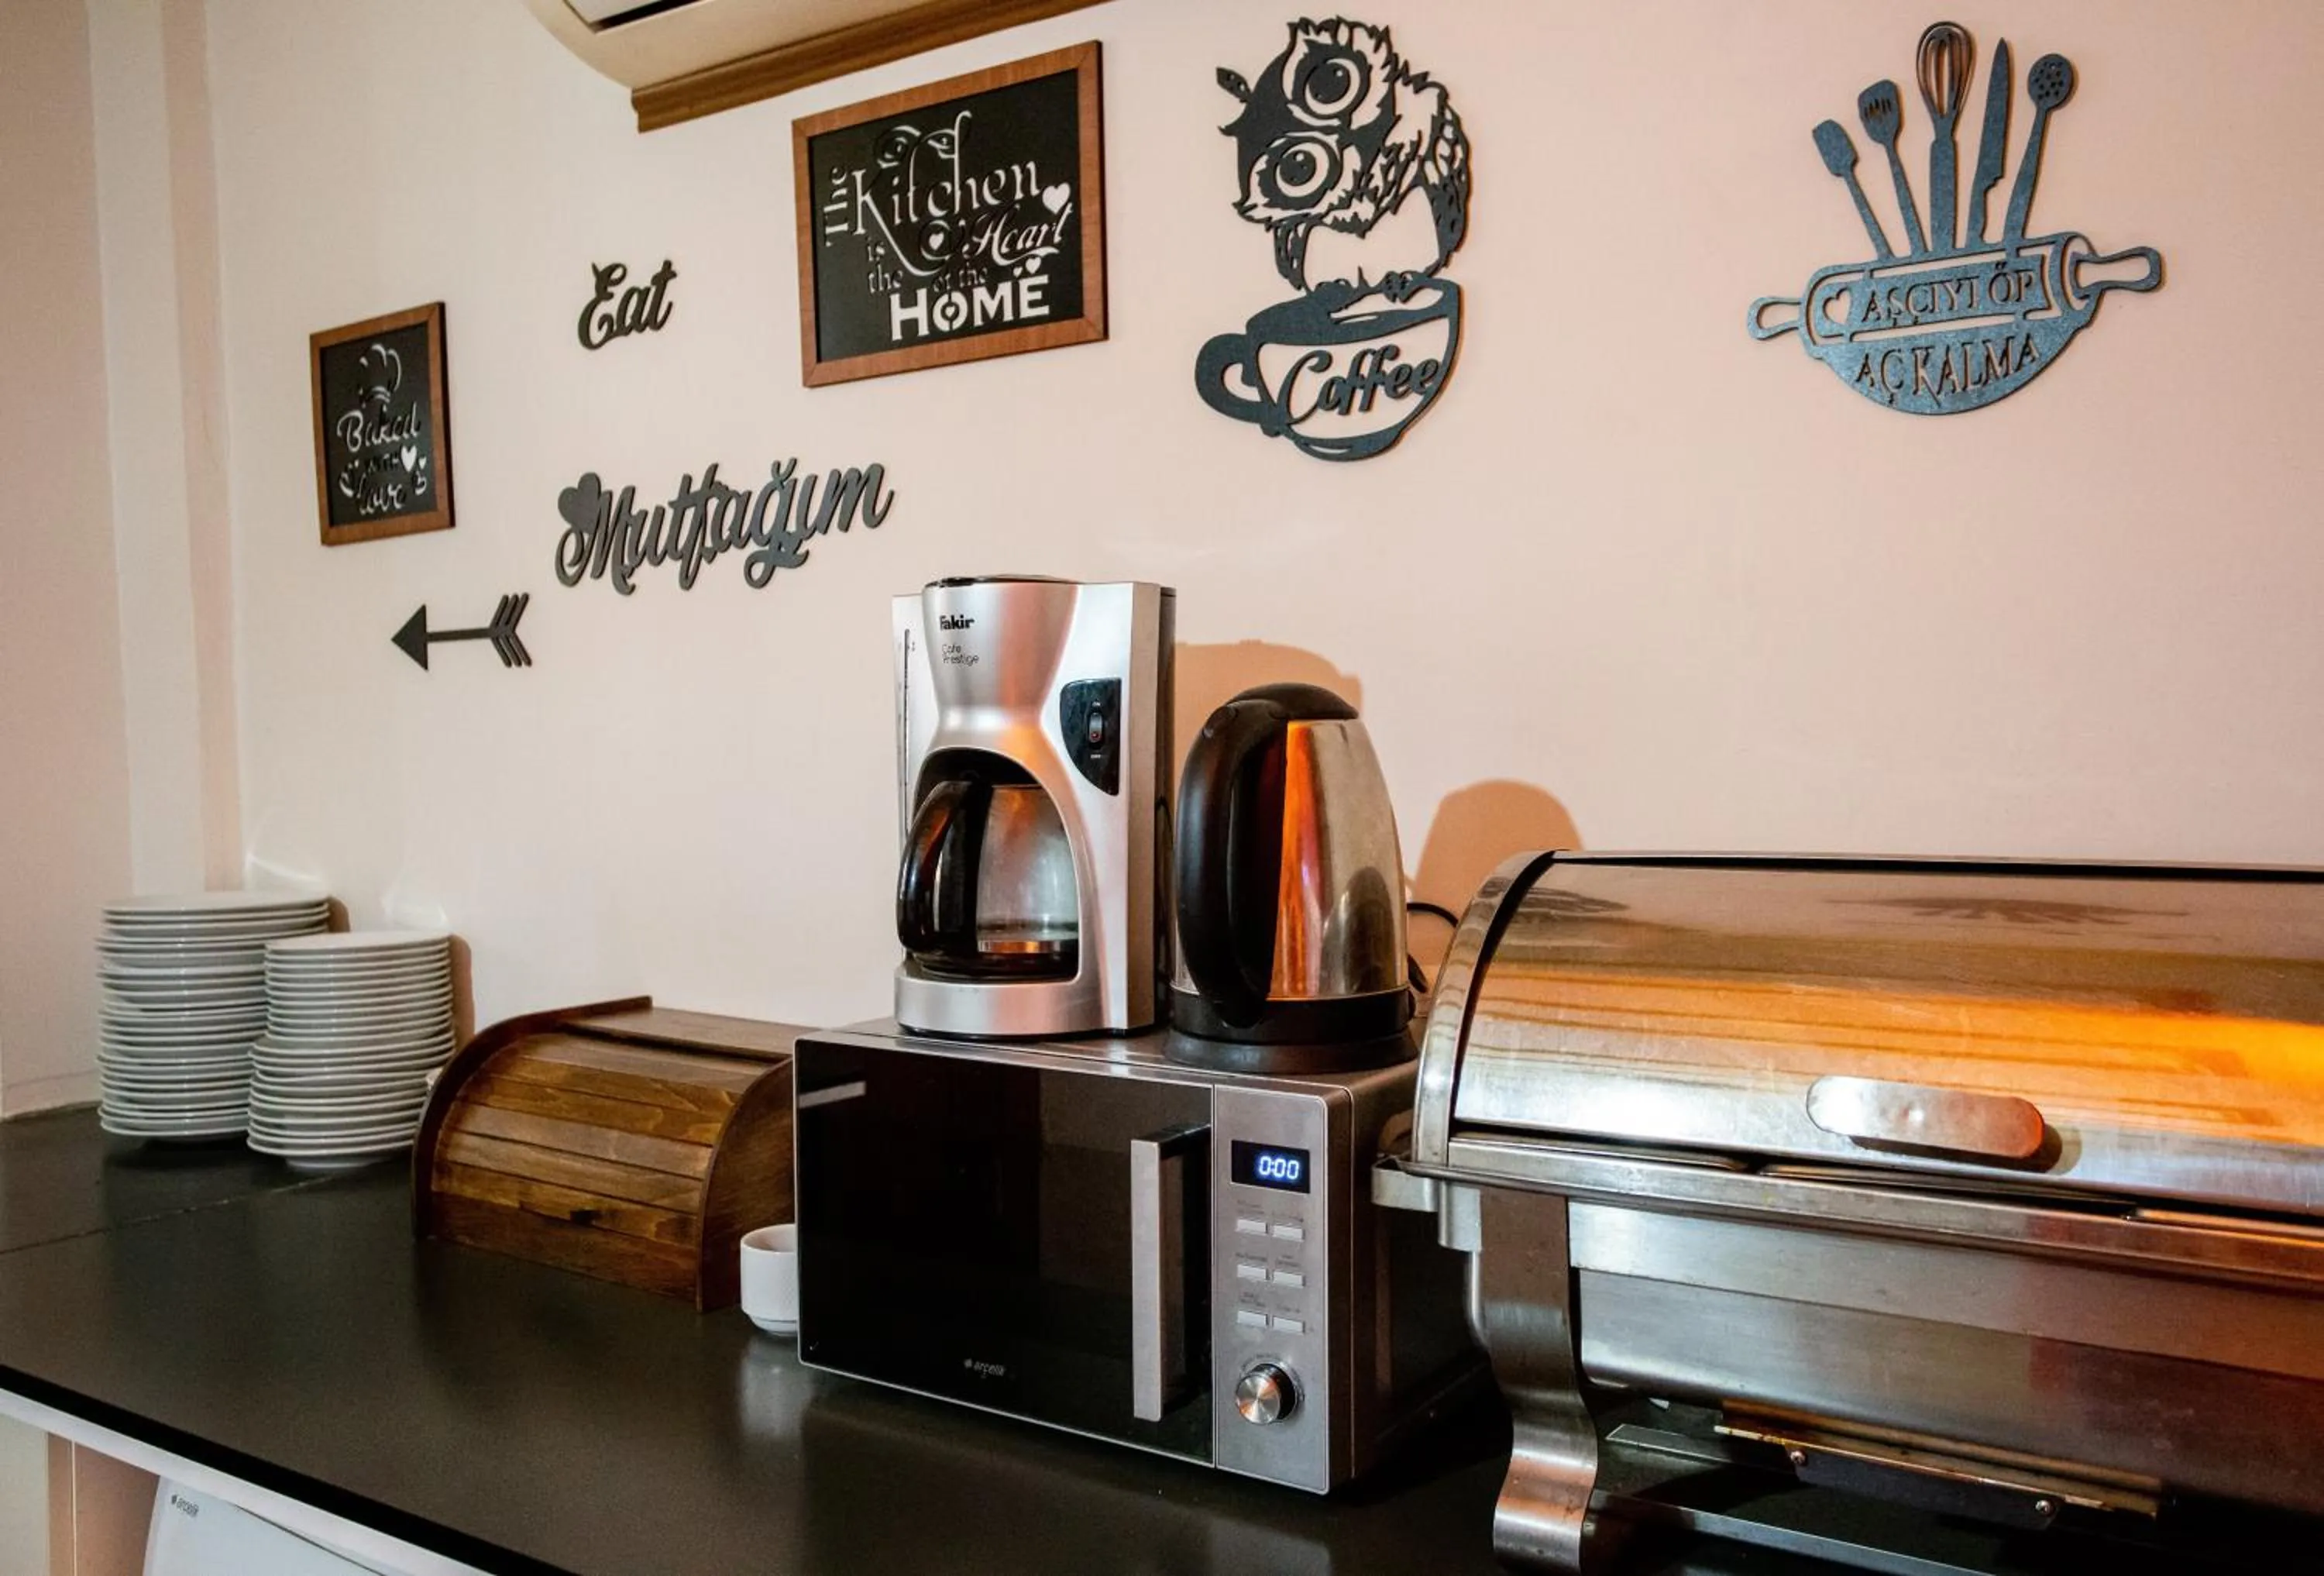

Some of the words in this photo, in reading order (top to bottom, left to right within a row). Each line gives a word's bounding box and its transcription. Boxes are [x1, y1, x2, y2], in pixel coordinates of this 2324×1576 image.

[822, 166, 847, 246] The
[851, 110, 1040, 277] Kitchen
[866, 236, 885, 262] is
[868, 263, 904, 294] the
[959, 201, 1073, 266] Heart
[958, 261, 989, 289] the
[1988, 261, 2033, 305] ÖP
[577, 260, 678, 350] Eat
[889, 274, 1050, 341] HOME
[1277, 344, 1442, 425] Coffee
[1855, 349, 1904, 404] AÇ
[1911, 332, 2040, 408] KALMA
[336, 401, 419, 452] Baked
[555, 457, 895, 596] Mutfağım
[1259, 1155, 1300, 1180] 0:00
